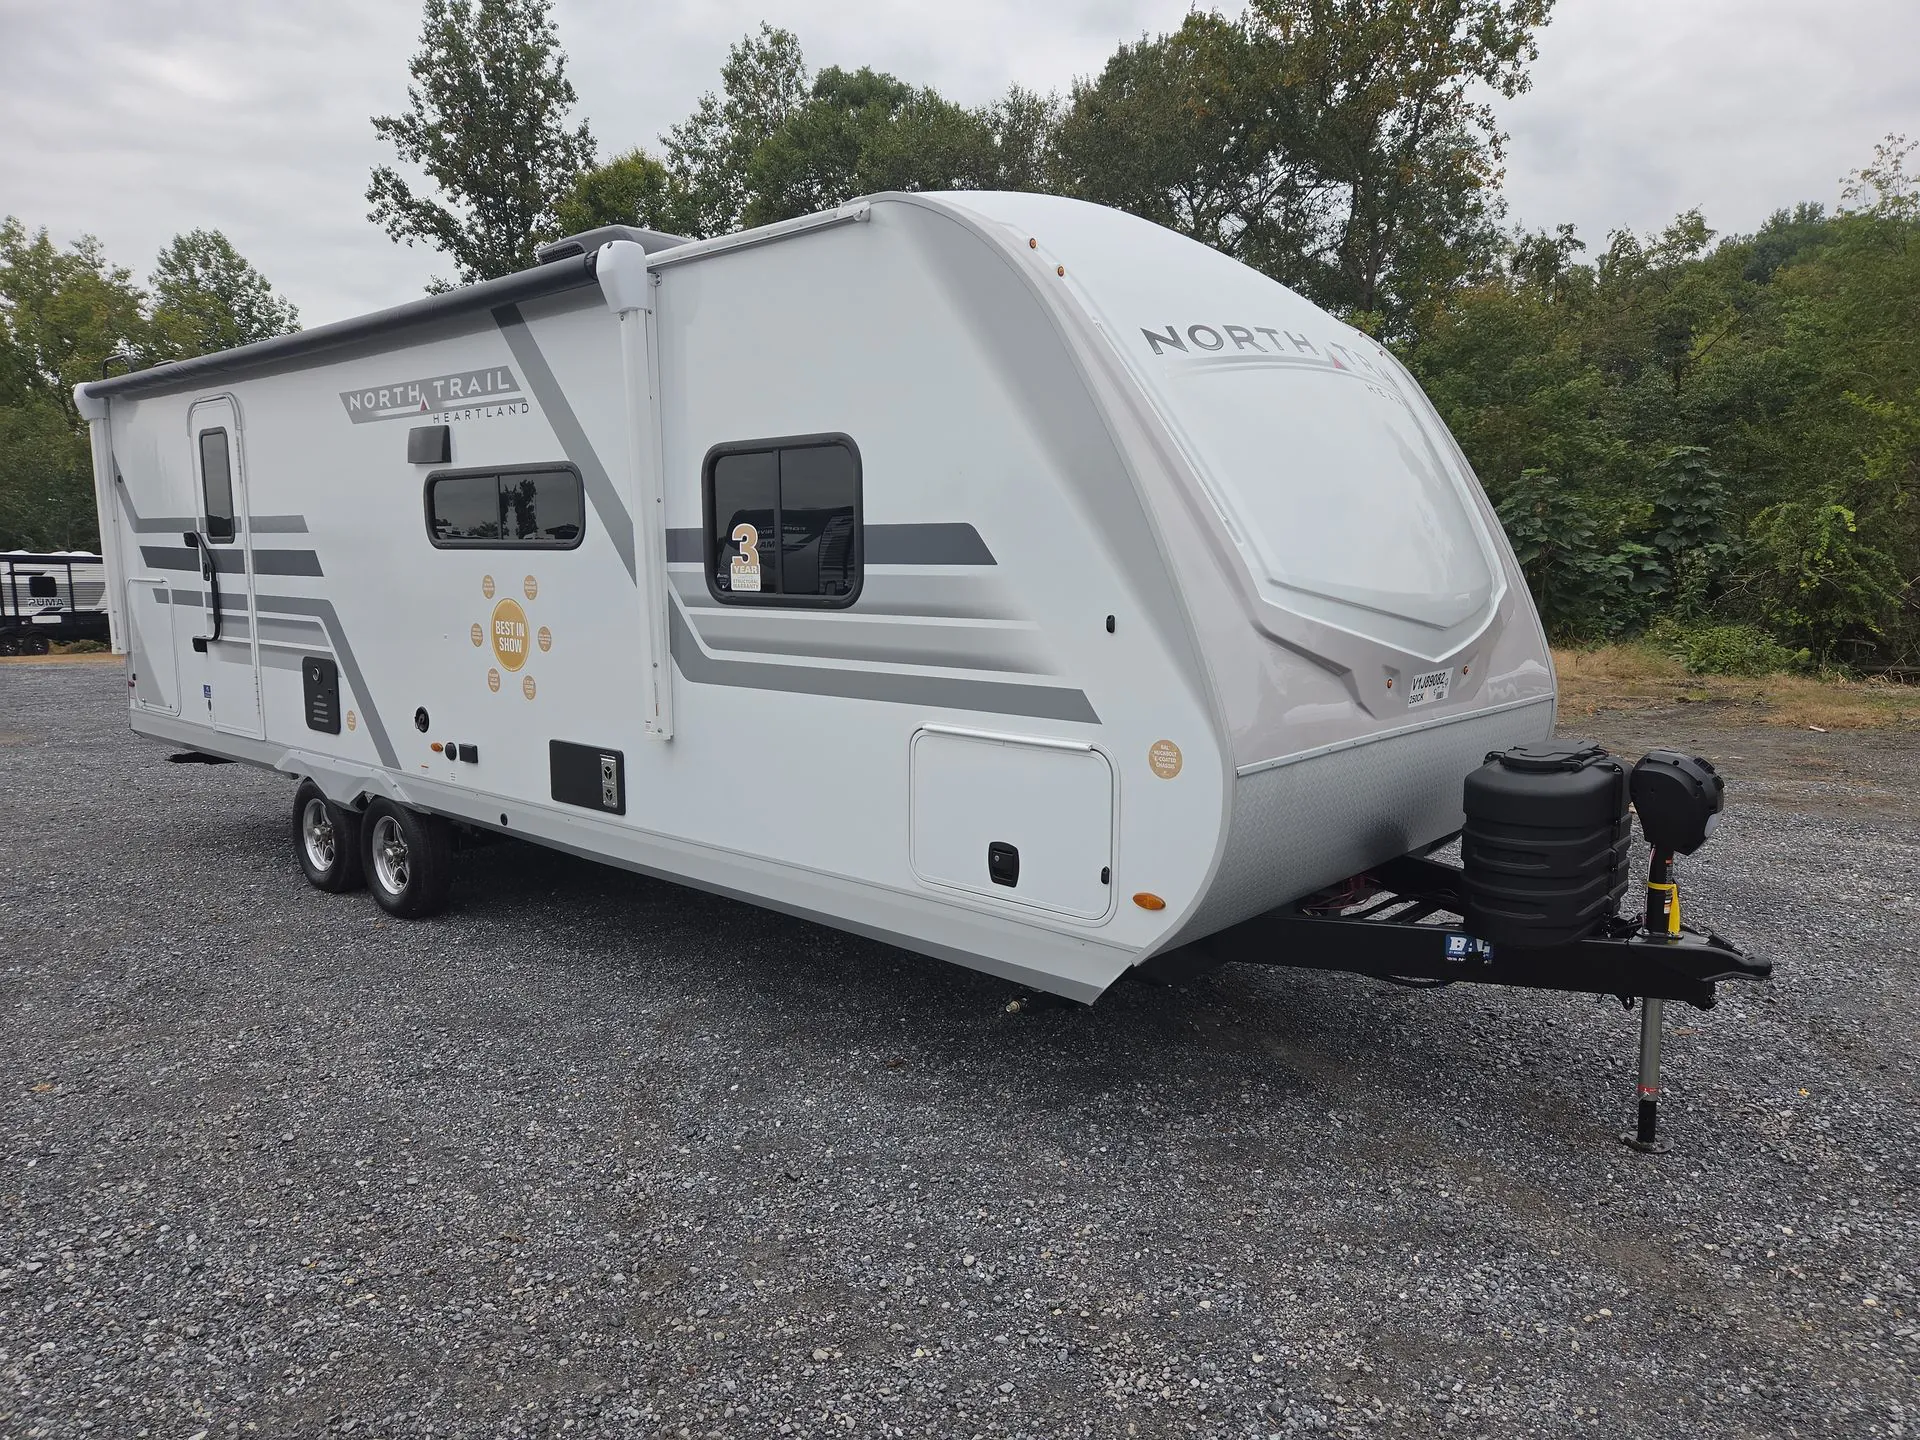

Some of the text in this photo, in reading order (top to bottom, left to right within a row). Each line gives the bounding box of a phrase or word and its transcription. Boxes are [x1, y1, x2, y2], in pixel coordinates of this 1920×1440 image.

[1140, 324, 1320, 356] NORTH
[350, 371, 510, 411] NORTH TRAIL
[433, 403, 529, 424] HEARTLAND
[732, 523, 759, 566] 3
[734, 565, 758, 574] YEAR
[28, 598, 64, 607] PUMA
[495, 620, 514, 636] BEST
[516, 622, 525, 637] IN
[499, 637, 522, 653] SHOW
